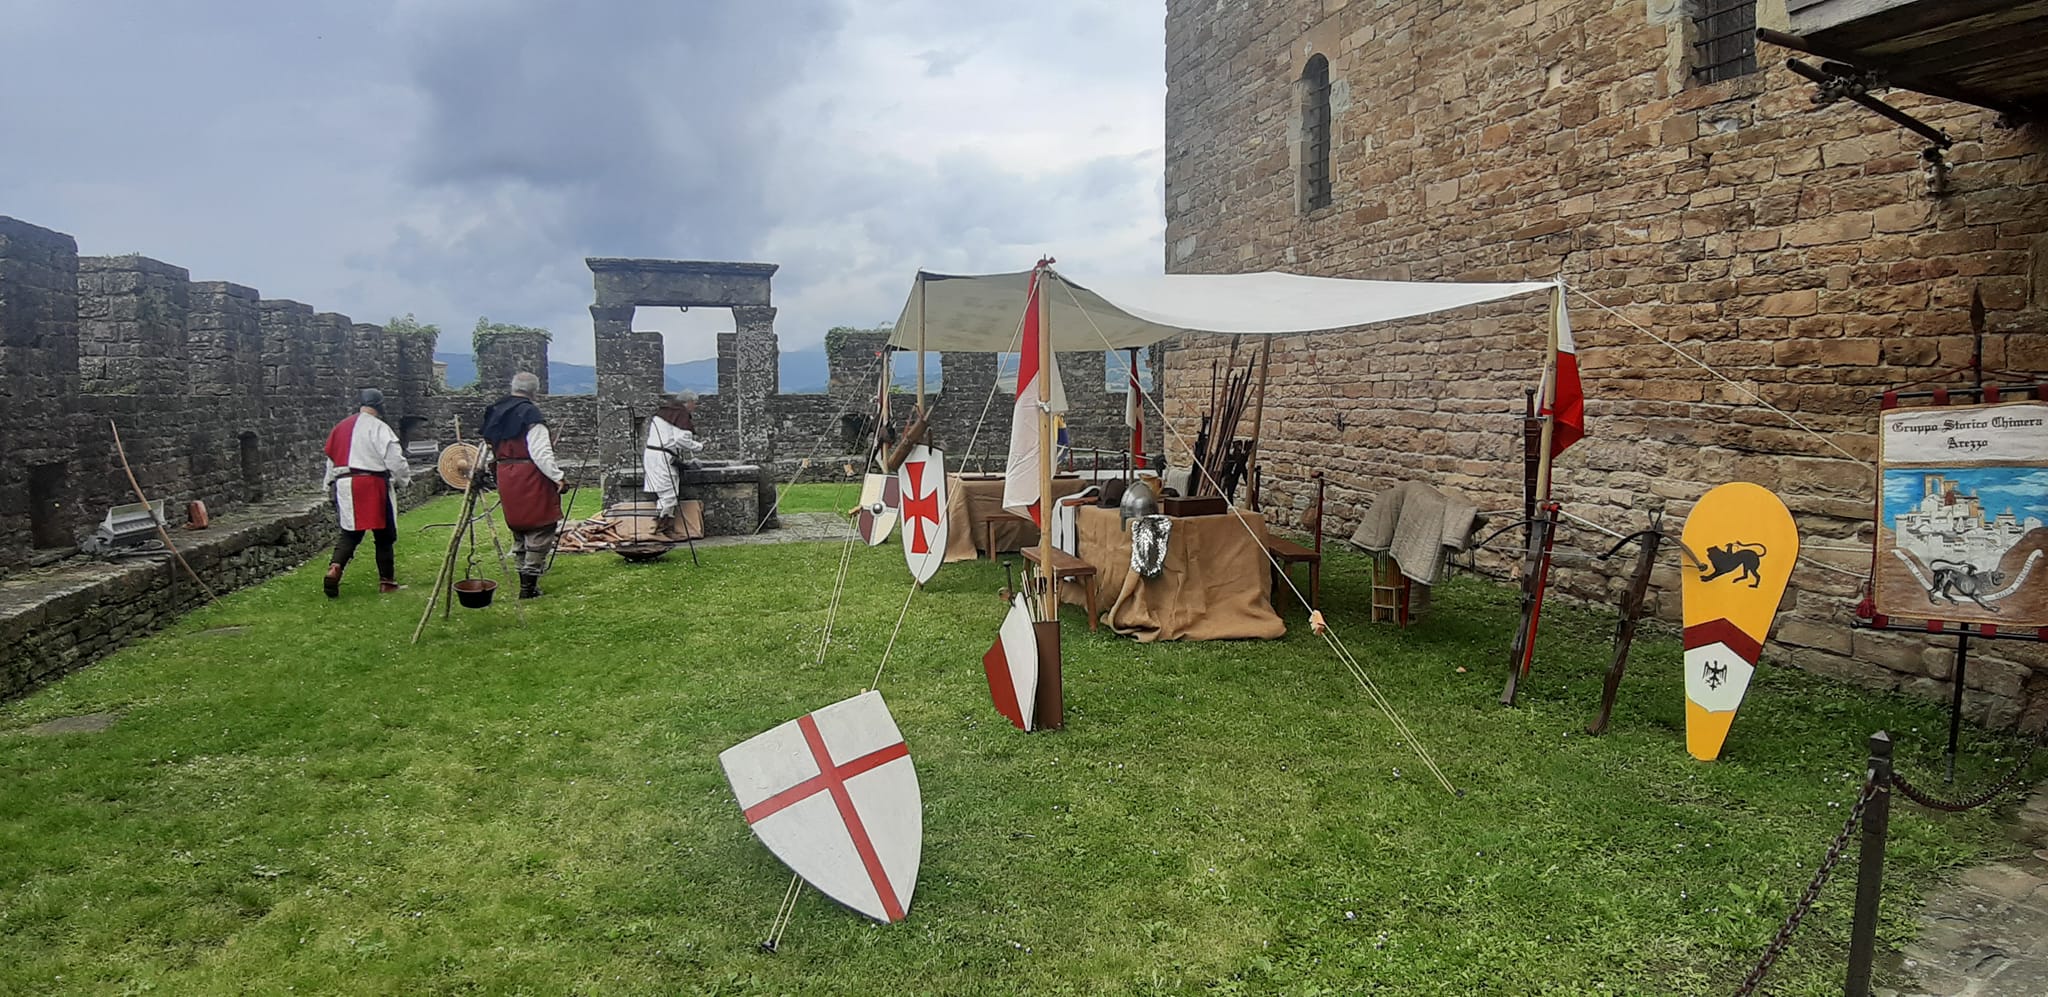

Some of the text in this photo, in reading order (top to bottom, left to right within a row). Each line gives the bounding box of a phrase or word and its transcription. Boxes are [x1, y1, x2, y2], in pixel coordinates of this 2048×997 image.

[1892, 416, 2043, 434] Gruppo Storico Chimera
[1947, 437, 1988, 451] Arezzo
